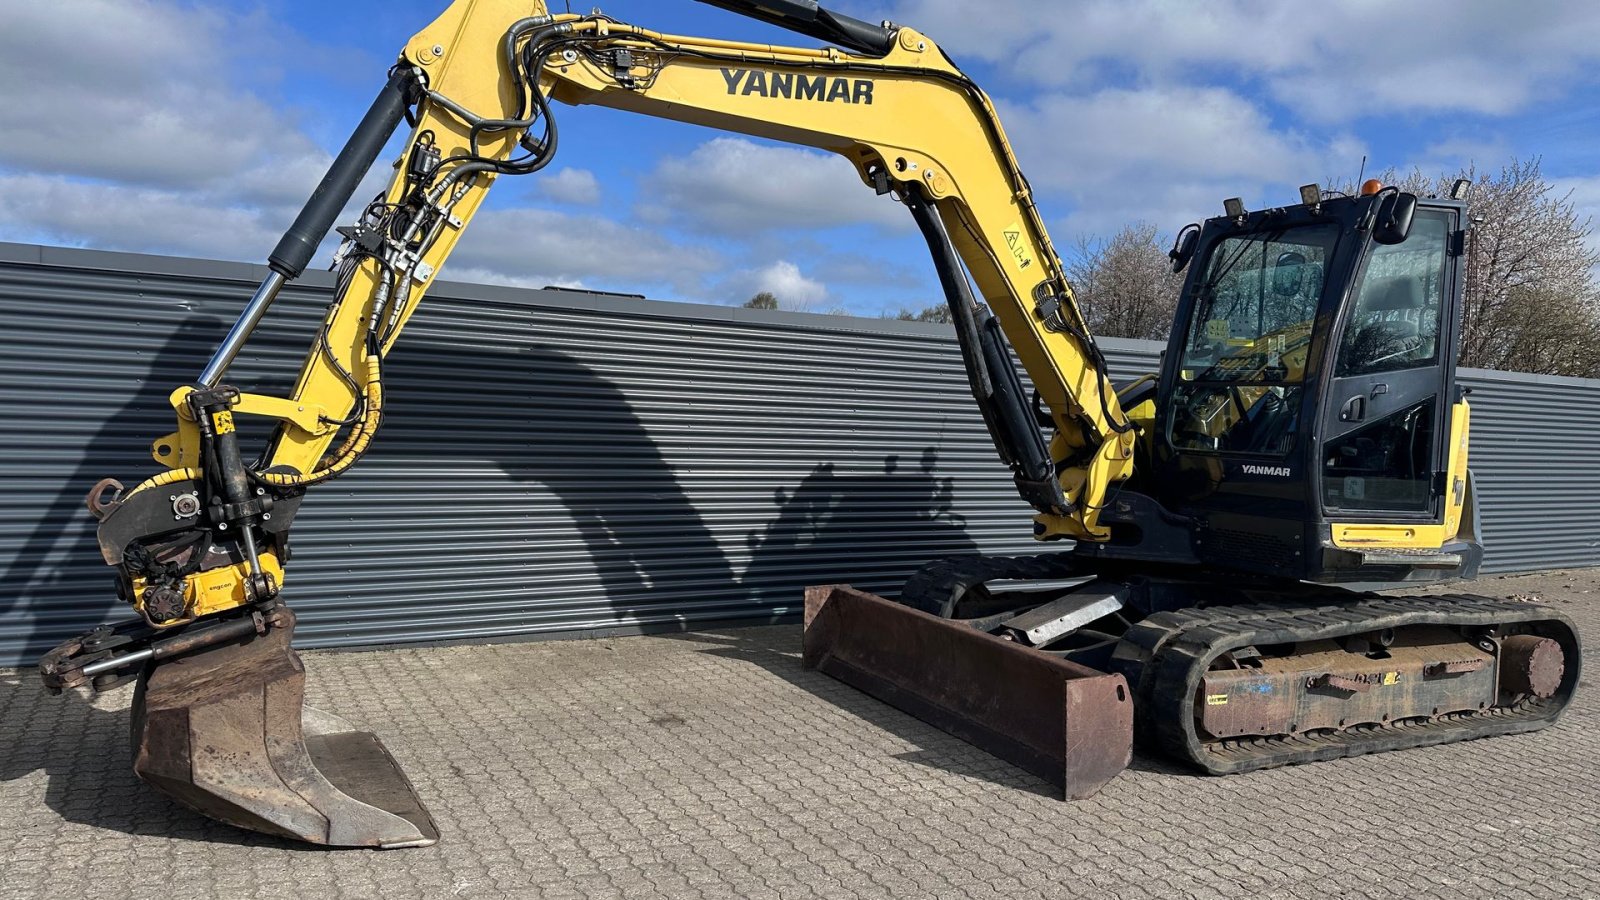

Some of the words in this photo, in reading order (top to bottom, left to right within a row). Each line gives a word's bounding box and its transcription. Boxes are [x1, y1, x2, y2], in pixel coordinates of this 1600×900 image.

[720, 68, 874, 105] YANMAR
[1242, 464, 1291, 477] YANMAR
[209, 582, 232, 591] engcon
